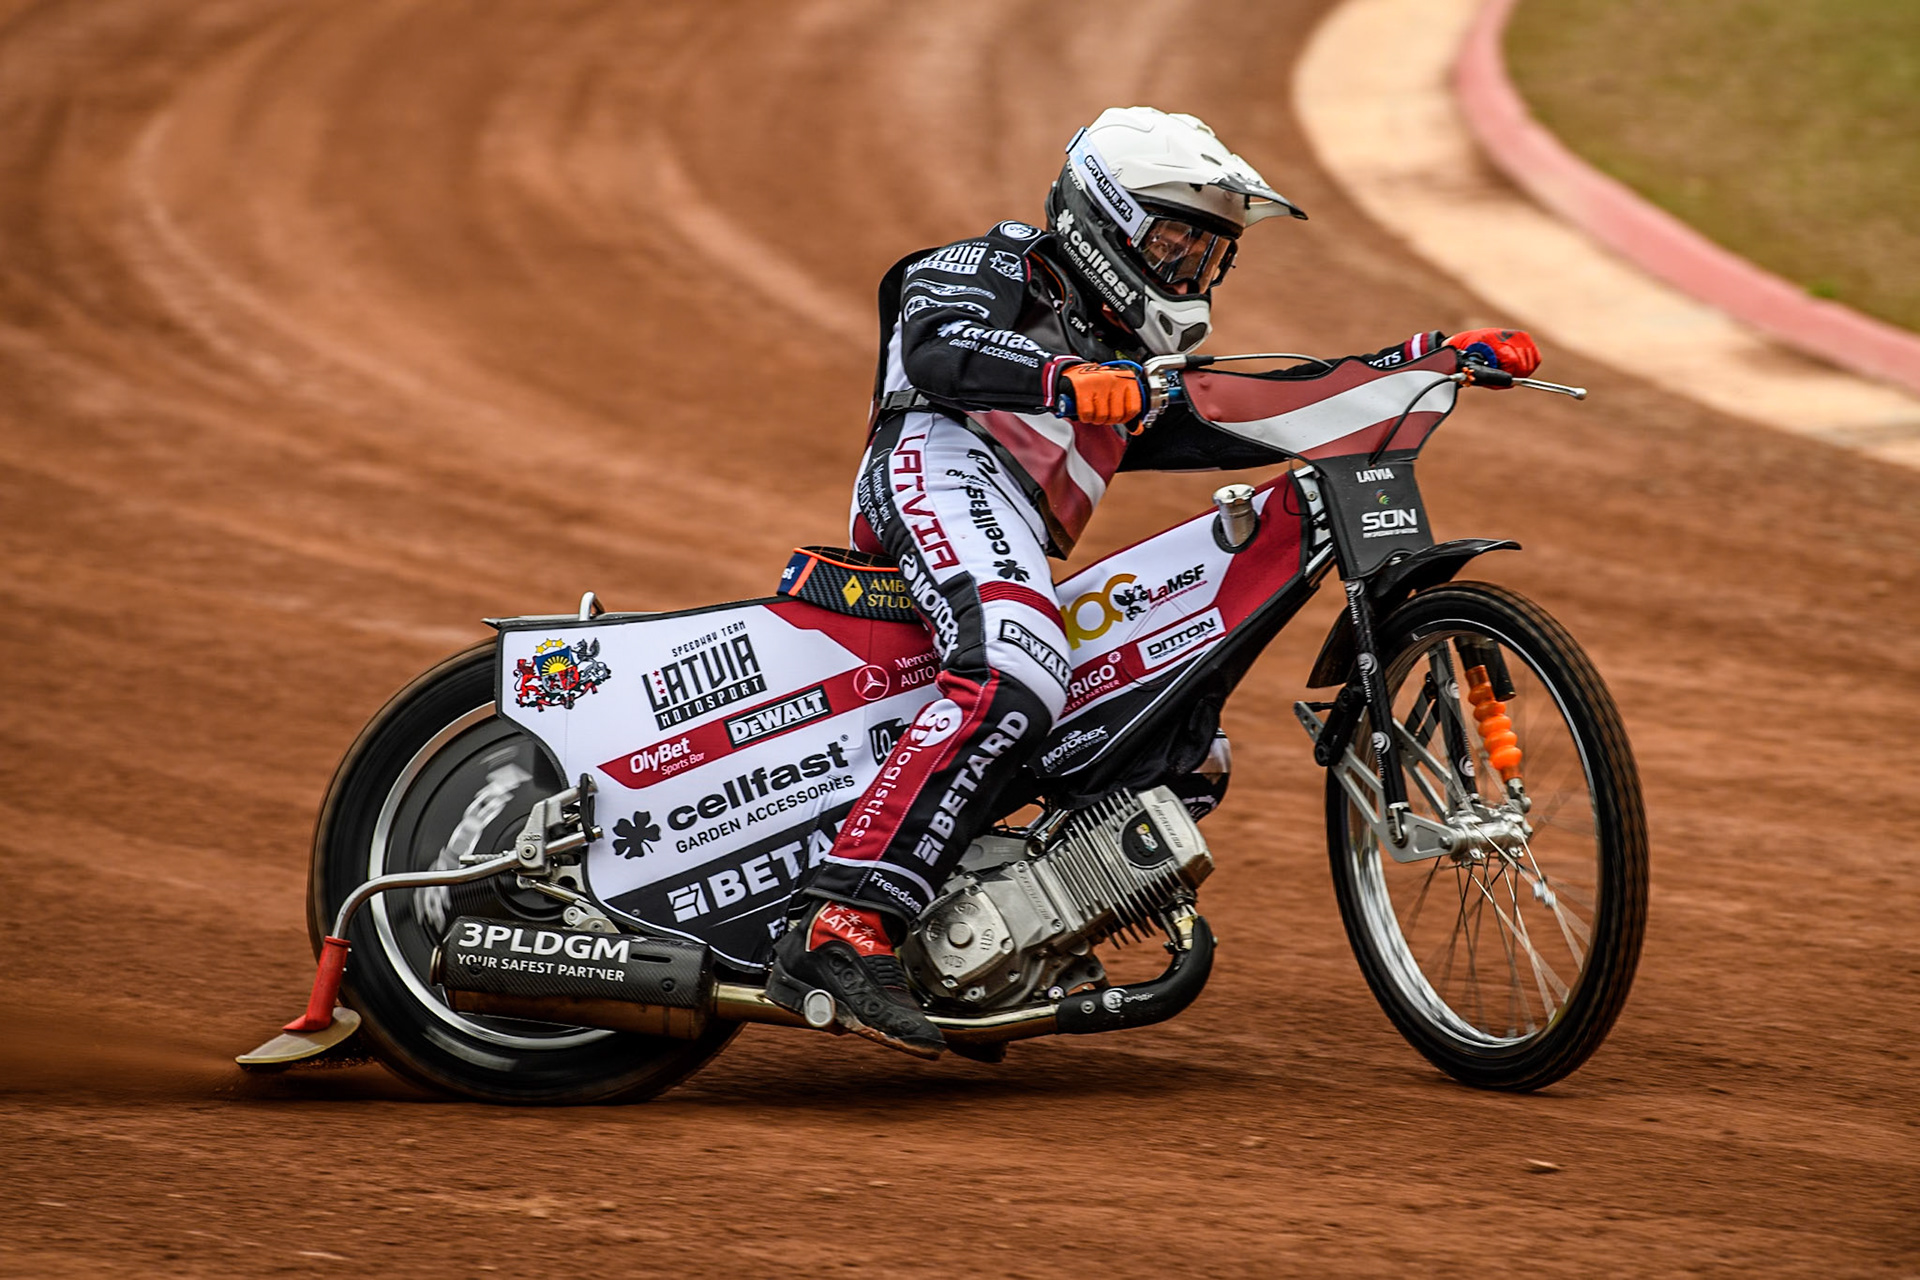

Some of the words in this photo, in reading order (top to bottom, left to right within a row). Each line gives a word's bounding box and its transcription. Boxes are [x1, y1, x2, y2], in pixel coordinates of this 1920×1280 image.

[1062, 241, 1086, 272] GARDEN
[1083, 266, 1126, 313] ACCESSORIES
[1070, 230, 1137, 305] cellfast
[980, 345, 1040, 369] ACCESSORIES
[1356, 467, 1395, 484] LATVIA
[894, 434, 960, 570] LATVIA
[1361, 508, 1418, 532] SON
[868, 594, 915, 609] STUD
[869, 579, 907, 593] AMB
[1148, 563, 1205, 604] LaMSF
[671, 634, 719, 657] SPEEDWAY
[721, 620, 746, 637] TEAM
[1148, 618, 1216, 656] DITTON
[901, 666, 935, 687] AUTO
[1067, 664, 1116, 700] RIGO
[660, 678, 761, 728] MOTOSPORT
[630, 737, 691, 775] OlyBet
[661, 755, 688, 776] Sports
[688, 751, 705, 767] Bar
[1041, 725, 1107, 768] MOTOREX
[668, 741, 850, 831] cellfast
[849, 745, 922, 842] logistics
[929, 711, 1029, 840] BETARD
[675, 817, 742, 853] GARDEN
[746, 774, 856, 826] ACCESSORIES
[707, 815, 845, 910] BETA
[870, 870, 924, 914] Freedom
[458, 922, 631, 964] 3PLDGM
[819, 906, 876, 952] LATVIA
[456, 953, 498, 970] YOUR
[500, 956, 554, 975] SAFEST
[557, 962, 625, 983] PARTNER
